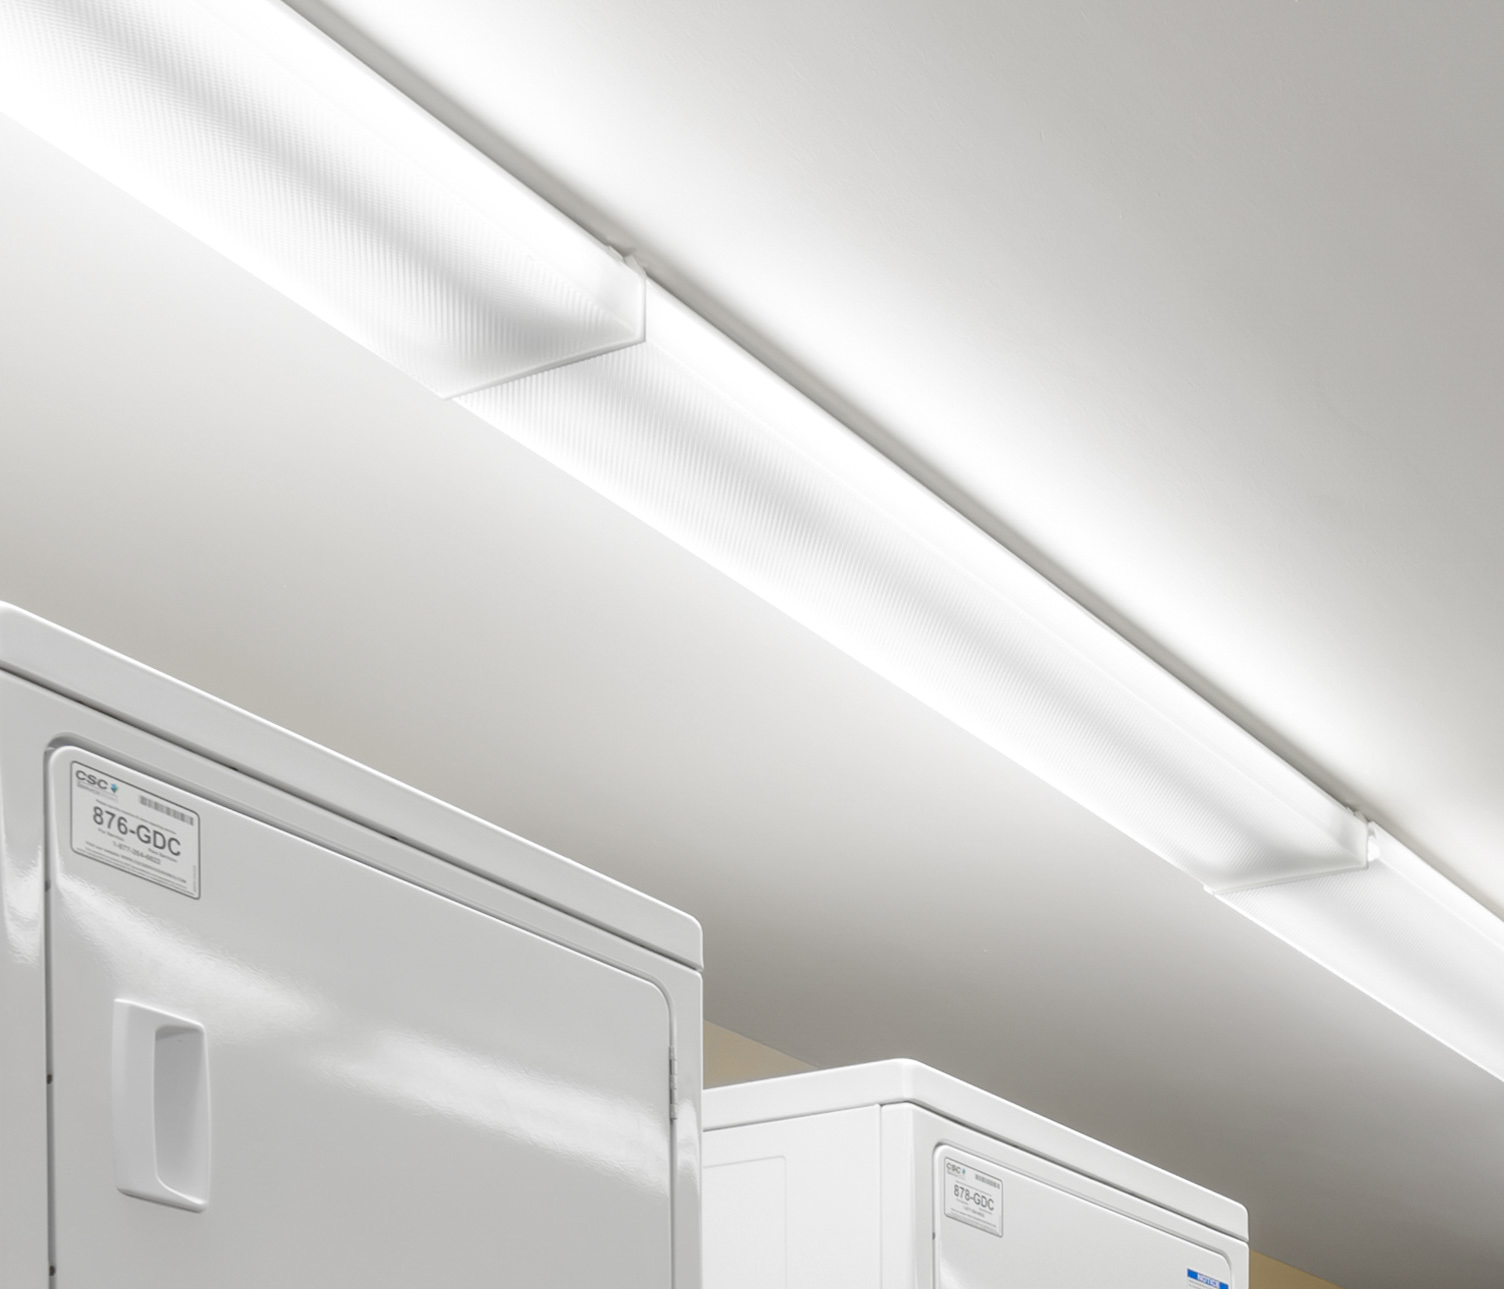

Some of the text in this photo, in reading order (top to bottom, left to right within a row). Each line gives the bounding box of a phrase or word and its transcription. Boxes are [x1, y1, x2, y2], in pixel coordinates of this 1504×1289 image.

[75, 769, 108, 790] CSC
[93, 806, 181, 857] 876-GDC
[953, 1184, 994, 1211] 878-GDC
